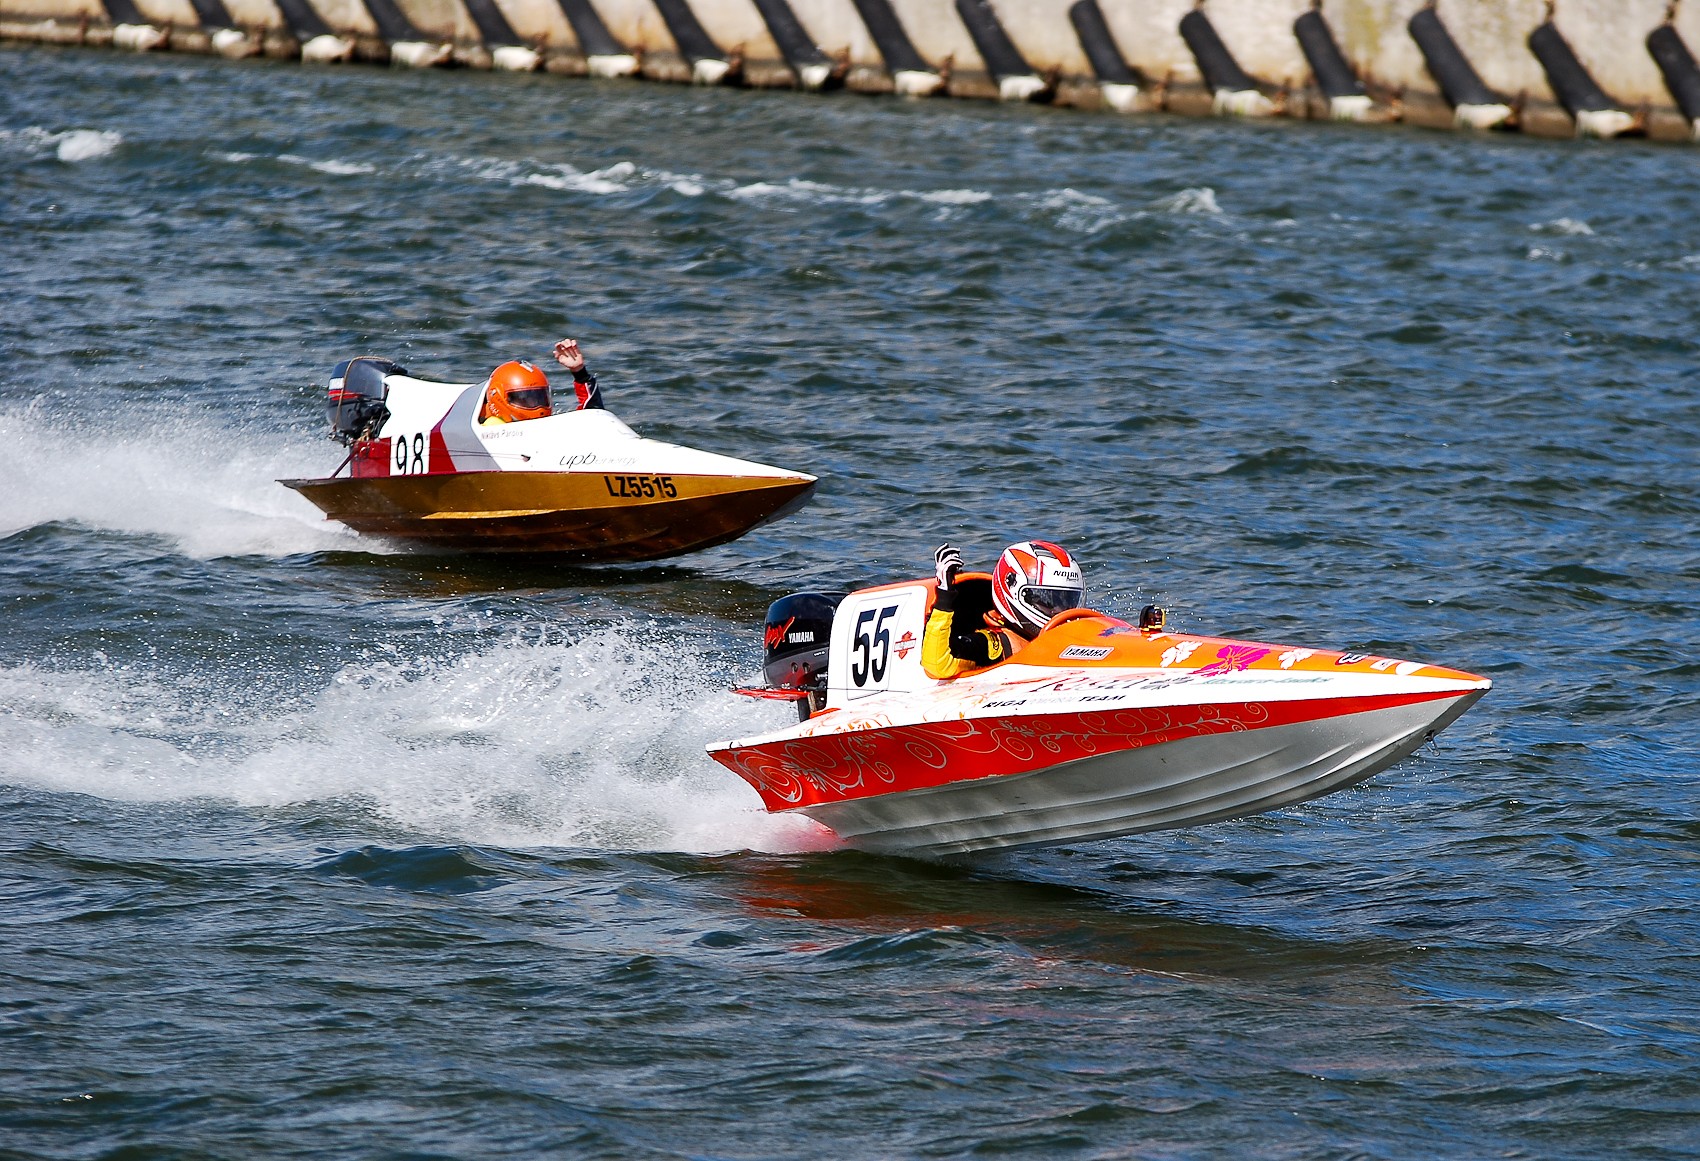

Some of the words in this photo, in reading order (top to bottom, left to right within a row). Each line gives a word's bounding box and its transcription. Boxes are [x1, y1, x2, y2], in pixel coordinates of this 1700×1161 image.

[396, 432, 424, 475] 98
[559, 452, 596, 469] upb
[603, 475, 678, 498] LZ5515
[1053, 570, 1079, 580] NOLAN
[788, 631, 815, 644] YAMAHA
[851, 604, 899, 688] 55
[1065, 647, 1108, 657] YAMAHA
[982, 699, 1027, 708] RIGA
